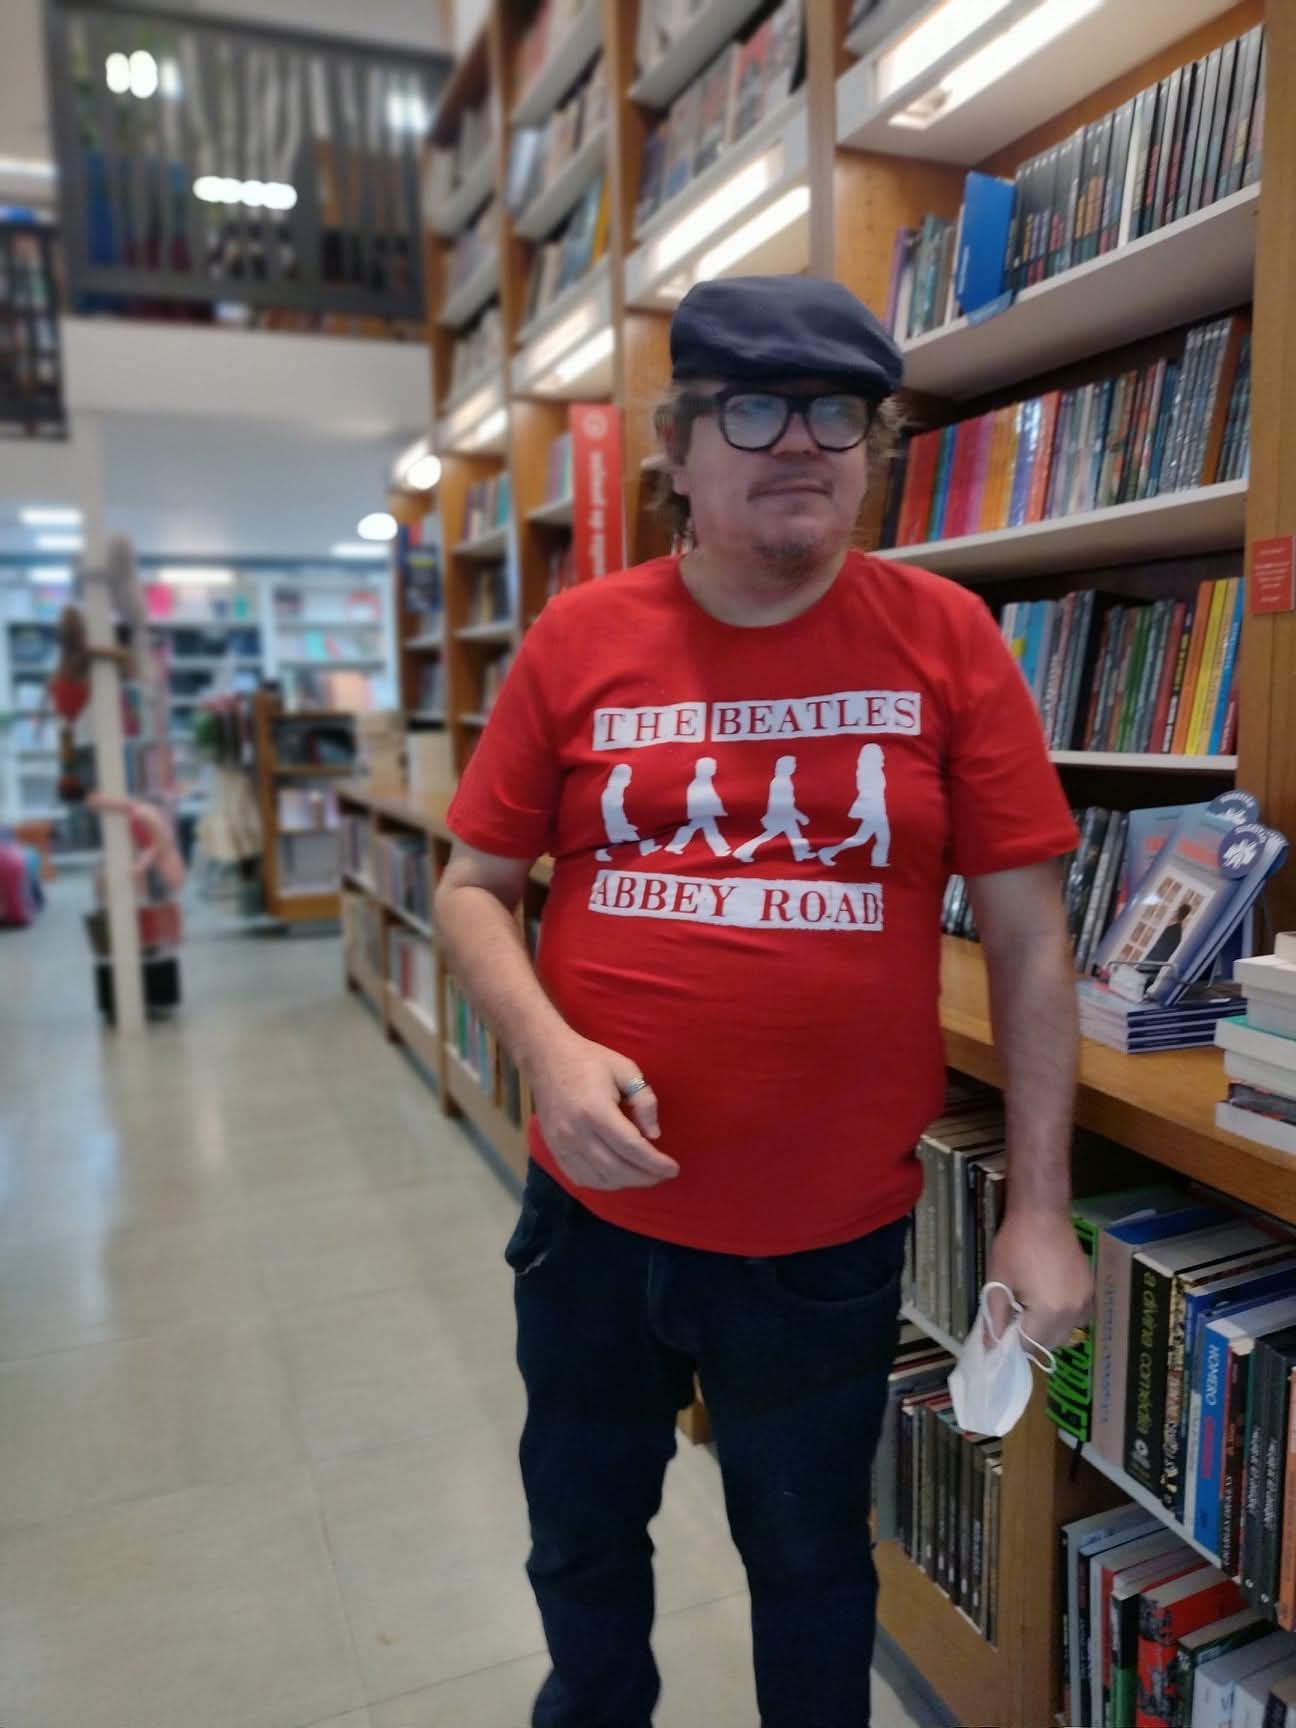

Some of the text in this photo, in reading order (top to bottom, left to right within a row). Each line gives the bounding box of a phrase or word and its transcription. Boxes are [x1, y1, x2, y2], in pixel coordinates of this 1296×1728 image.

[601, 696, 916, 743] THE BEATLES
[591, 876, 882, 925] ABBEY ROAD
[1205, 1344, 1221, 1406] HOMERO
